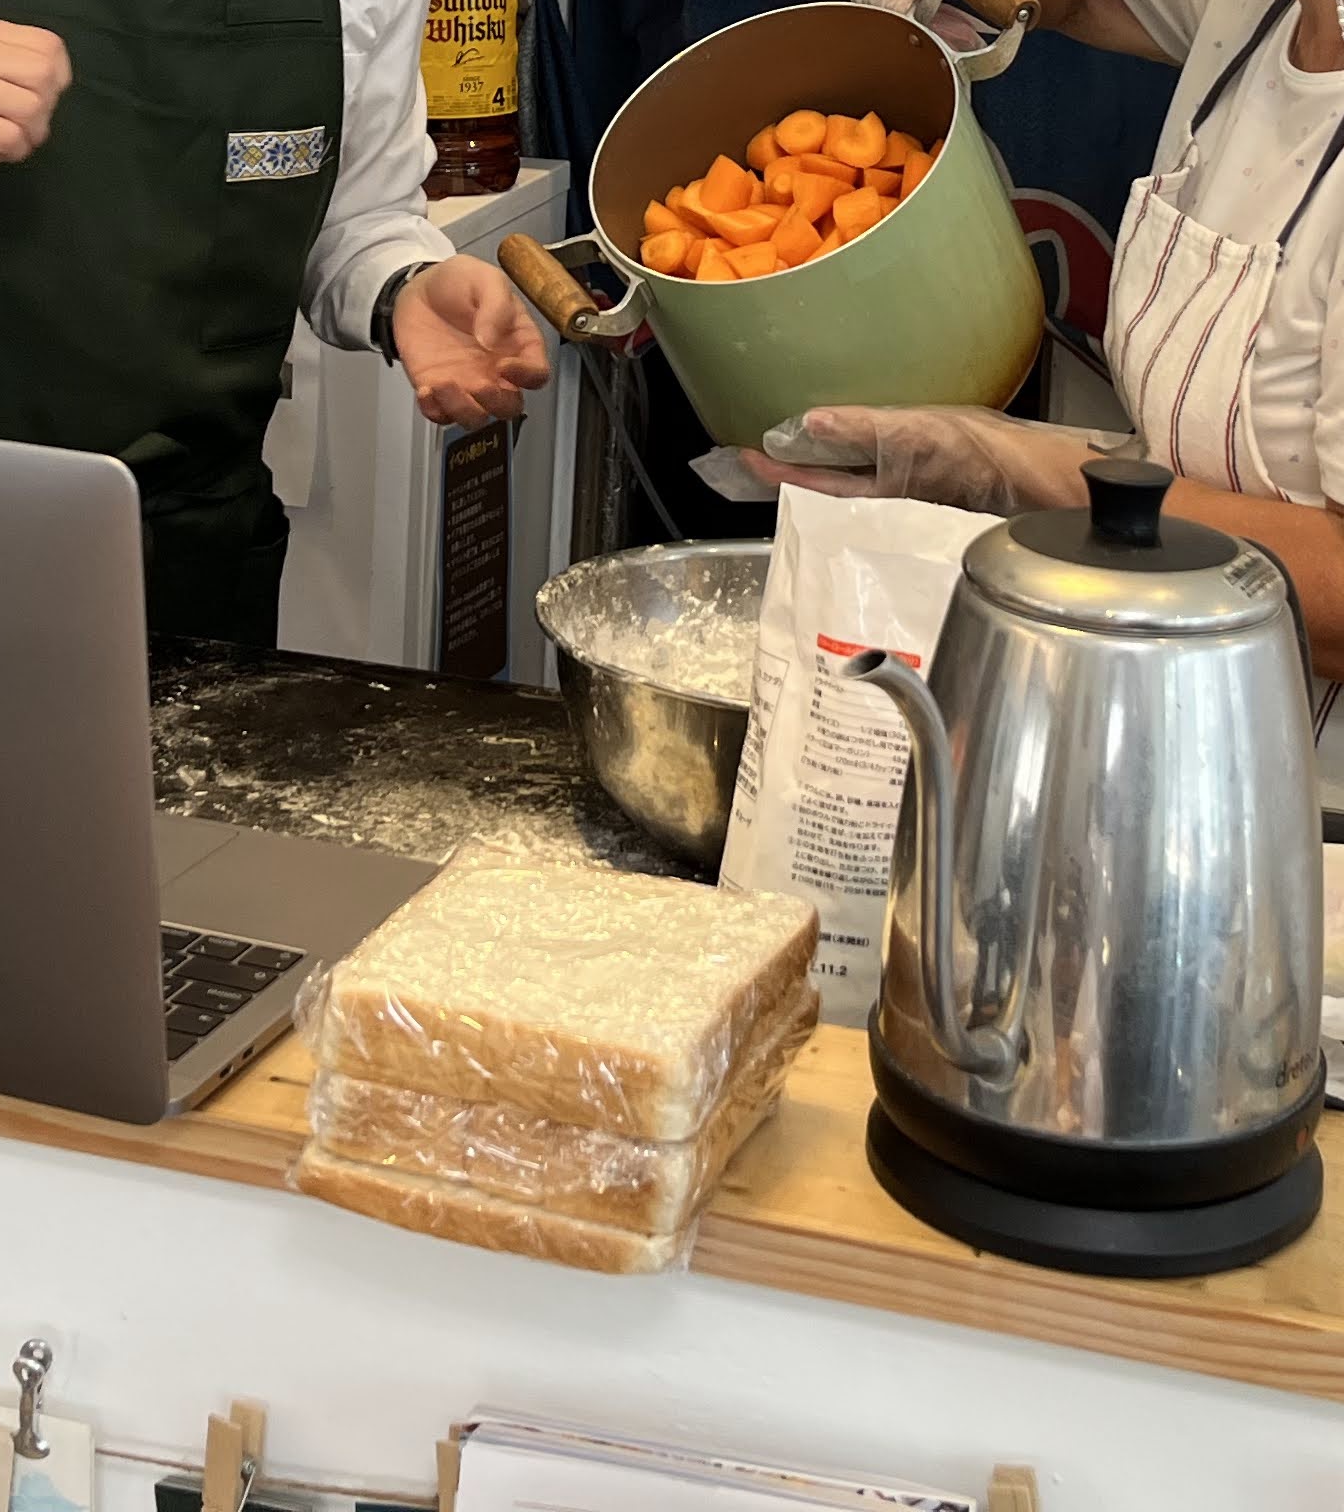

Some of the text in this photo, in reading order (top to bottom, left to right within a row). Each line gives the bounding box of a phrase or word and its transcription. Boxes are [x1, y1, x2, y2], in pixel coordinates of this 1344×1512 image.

[426, 15, 506, 46] Whisky
[459, 81, 484, 93] 1937
[492, 87, 505, 107] 4
